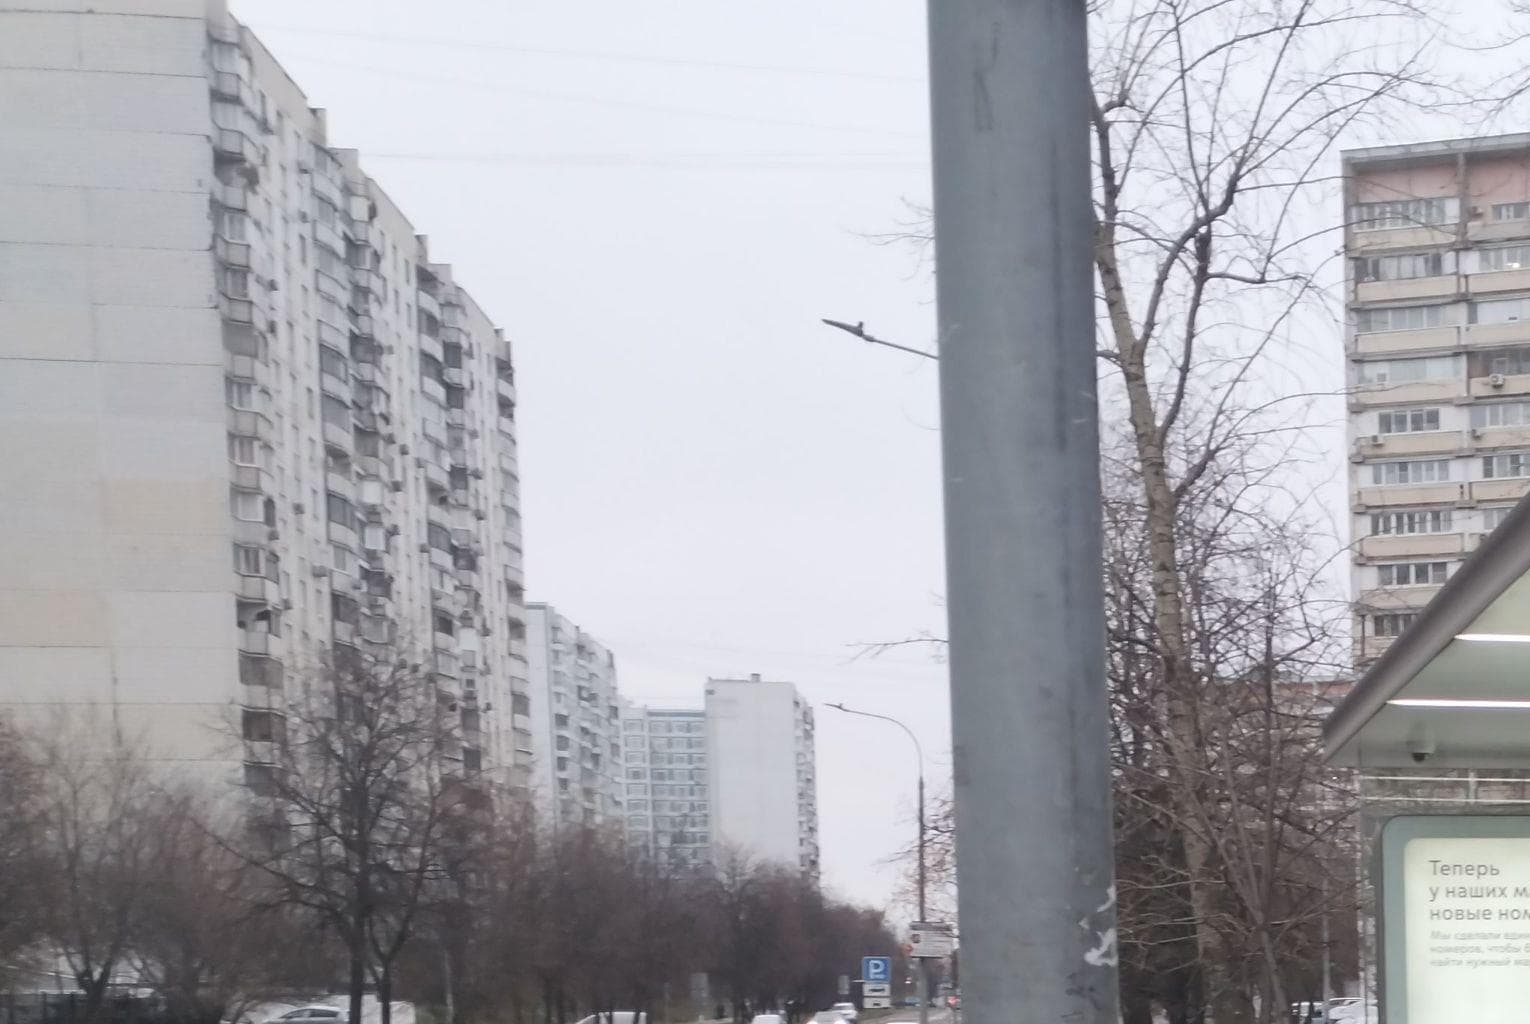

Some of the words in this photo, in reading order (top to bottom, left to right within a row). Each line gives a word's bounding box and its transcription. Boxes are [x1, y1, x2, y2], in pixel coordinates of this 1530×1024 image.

[1428, 860, 1500, 879] Теперь
[1428, 885, 1440, 902] у
[1444, 885, 1508, 899] наших
[1429, 908, 1493, 921] новые
